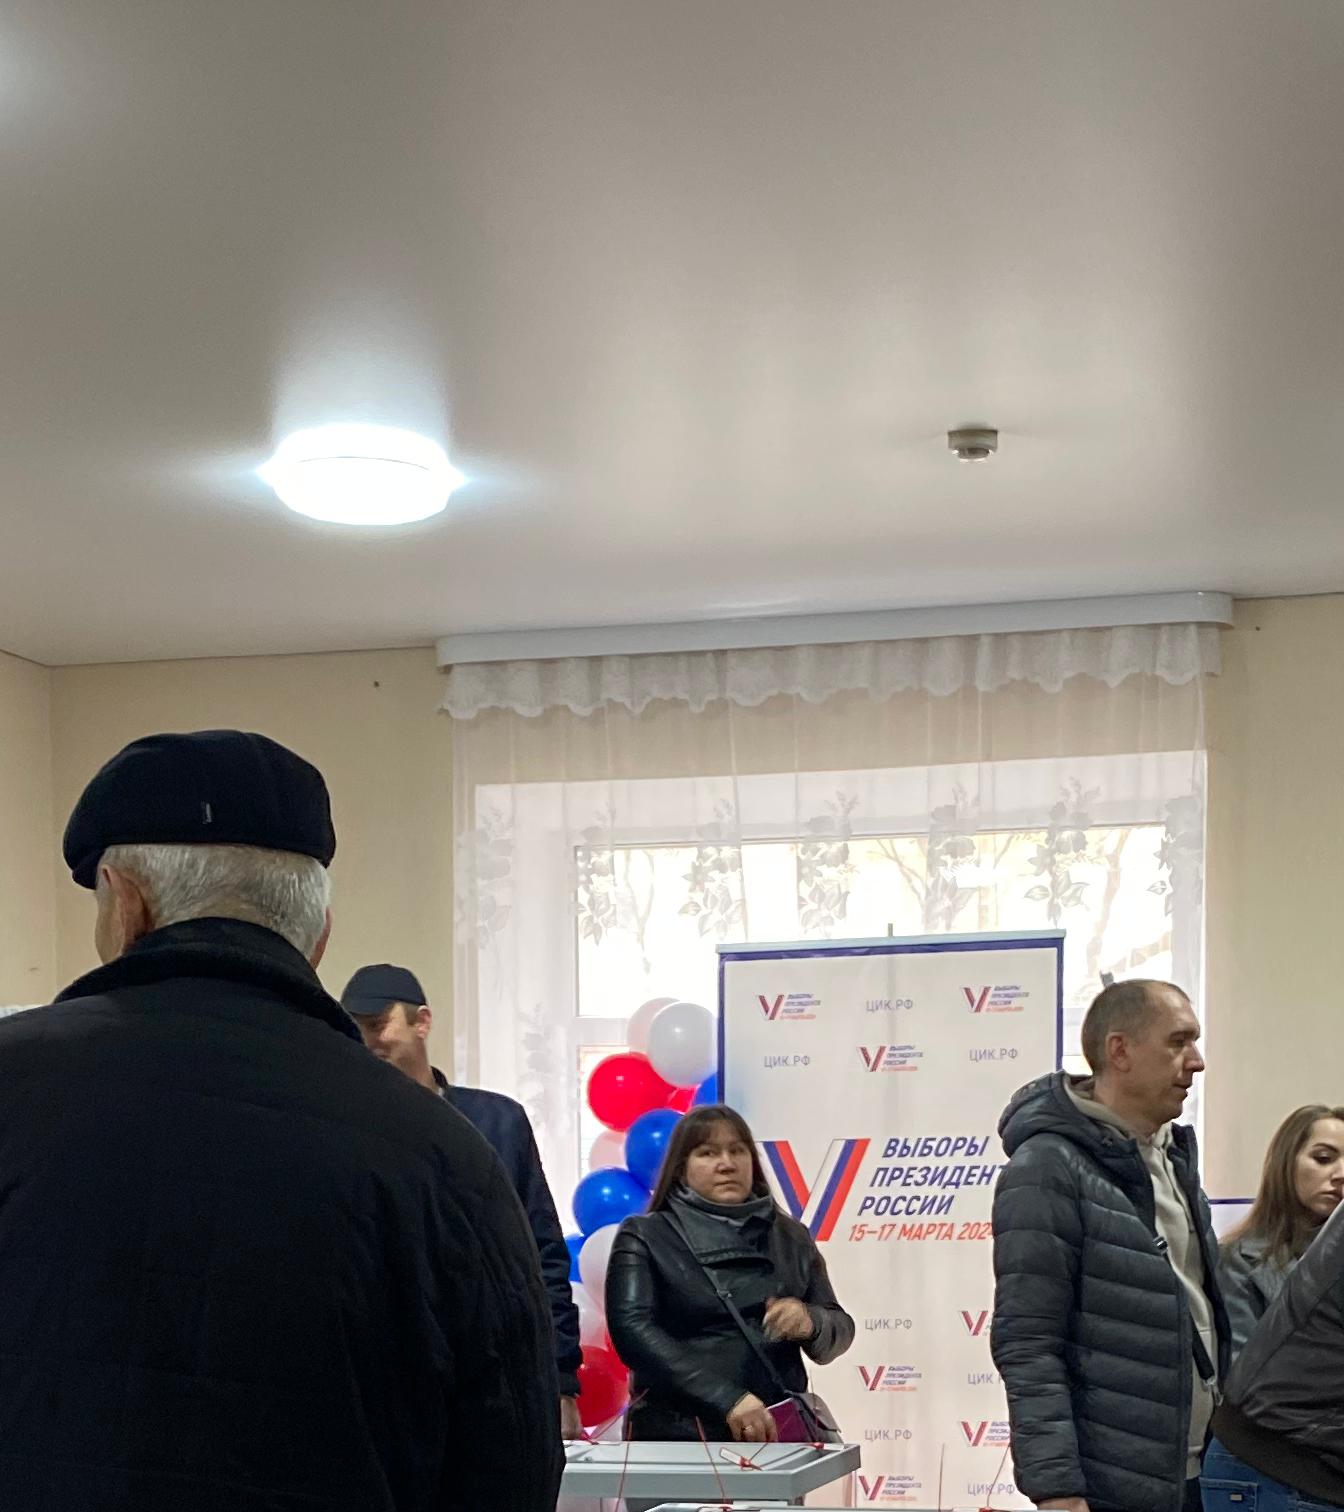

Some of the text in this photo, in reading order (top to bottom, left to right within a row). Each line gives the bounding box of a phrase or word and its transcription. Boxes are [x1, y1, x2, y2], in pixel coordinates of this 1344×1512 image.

[882, 1136, 990, 1158] ВЫБОРЫ
[869, 1165, 1007, 1189] ПРЕЗИДЕН
[857, 1195, 955, 1216] РОССИИ
[897, 1223, 953, 1241] МАРТА
